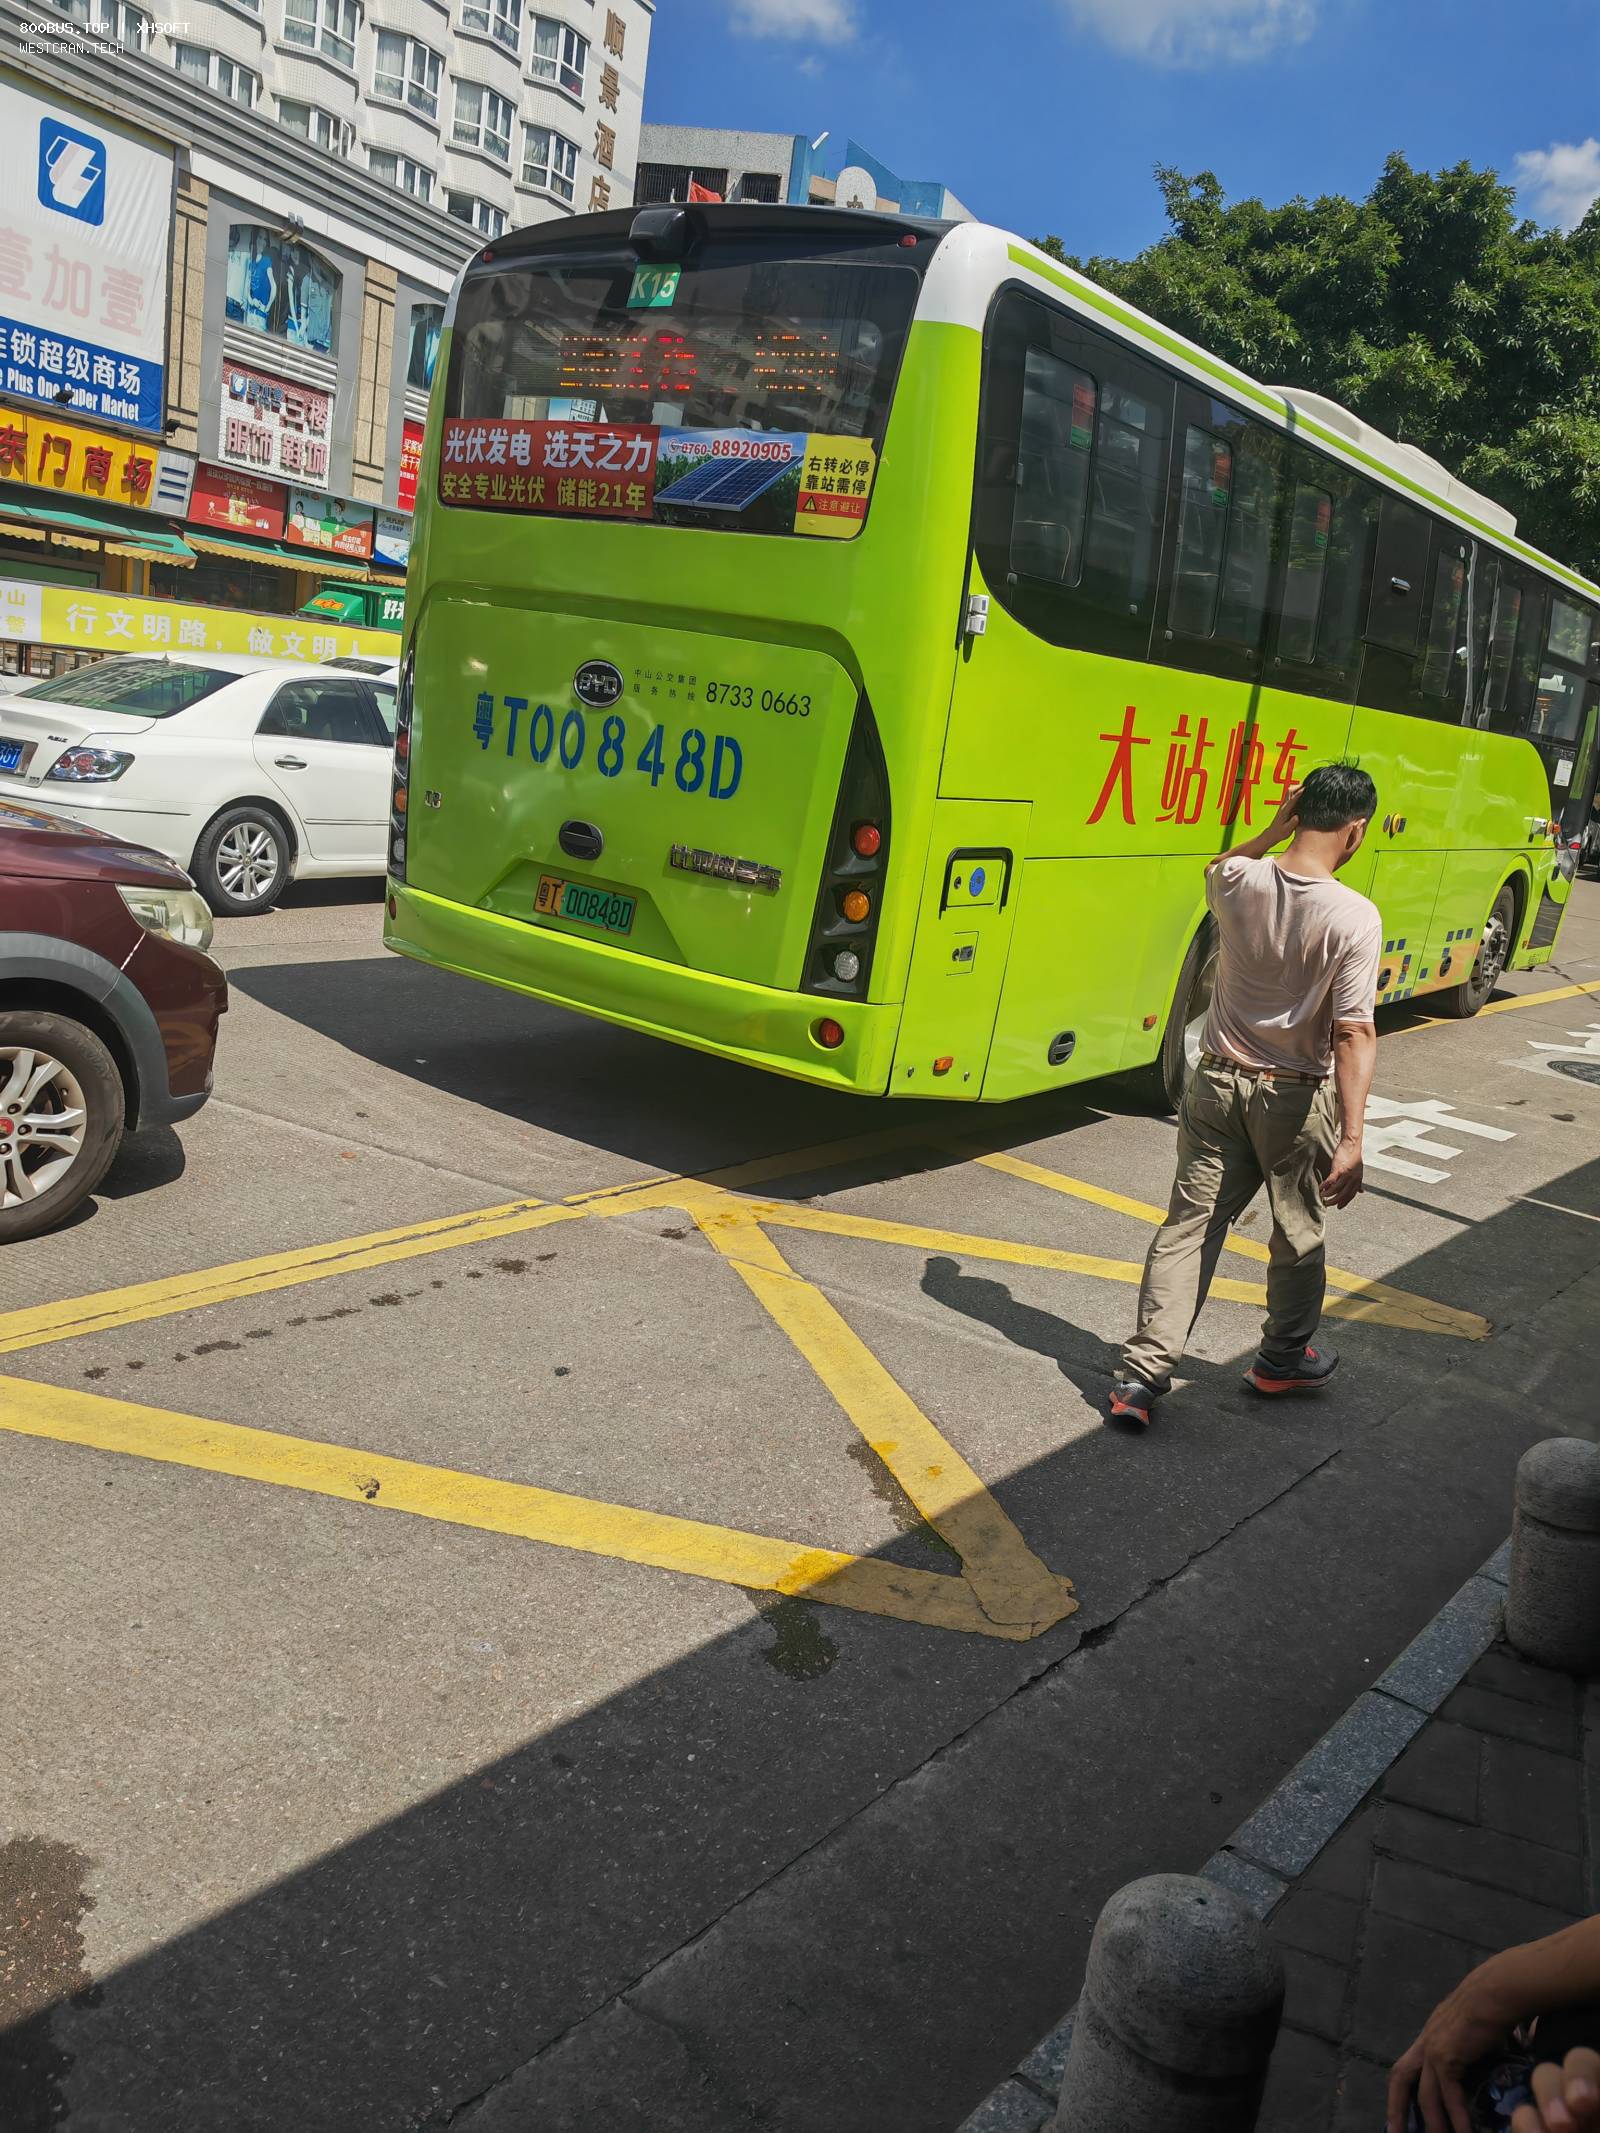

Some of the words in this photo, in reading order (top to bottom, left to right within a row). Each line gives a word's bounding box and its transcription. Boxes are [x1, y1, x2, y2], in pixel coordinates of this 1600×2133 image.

[587, 8, 626, 212] 顺景酒店
[0, 227, 144, 337] 壹加壹
[630, 271, 680, 299] K15
[7, 367, 34, 394] Plus
[37, 375, 61, 399] One
[101, 392, 139, 421] Market
[285, 391, 328, 434] 三楼
[0, 424, 153, 492] 东门商场
[226, 417, 273, 461] 服饰
[444, 427, 532, 466] 光伏发电
[543, 430, 653, 473] 选天之力
[681, 440, 792, 461] 0760-88920905
[804, 474, 867, 495] 靠站需停
[808, 456, 871, 476] 右转必停
[442, 471, 545, 504] 安全专业光伏
[557, 477, 646, 512] 储能21年
[818, 498, 861, 514] 注意避让
[0, 589, 26, 606] 山
[579, 673, 618, 695] BYD
[633, 668, 697, 686] 中山公交集团
[706, 682, 753, 709] 8733
[761, 690, 811, 717] 0663
[1086, 706, 1308, 825] 大站快车
